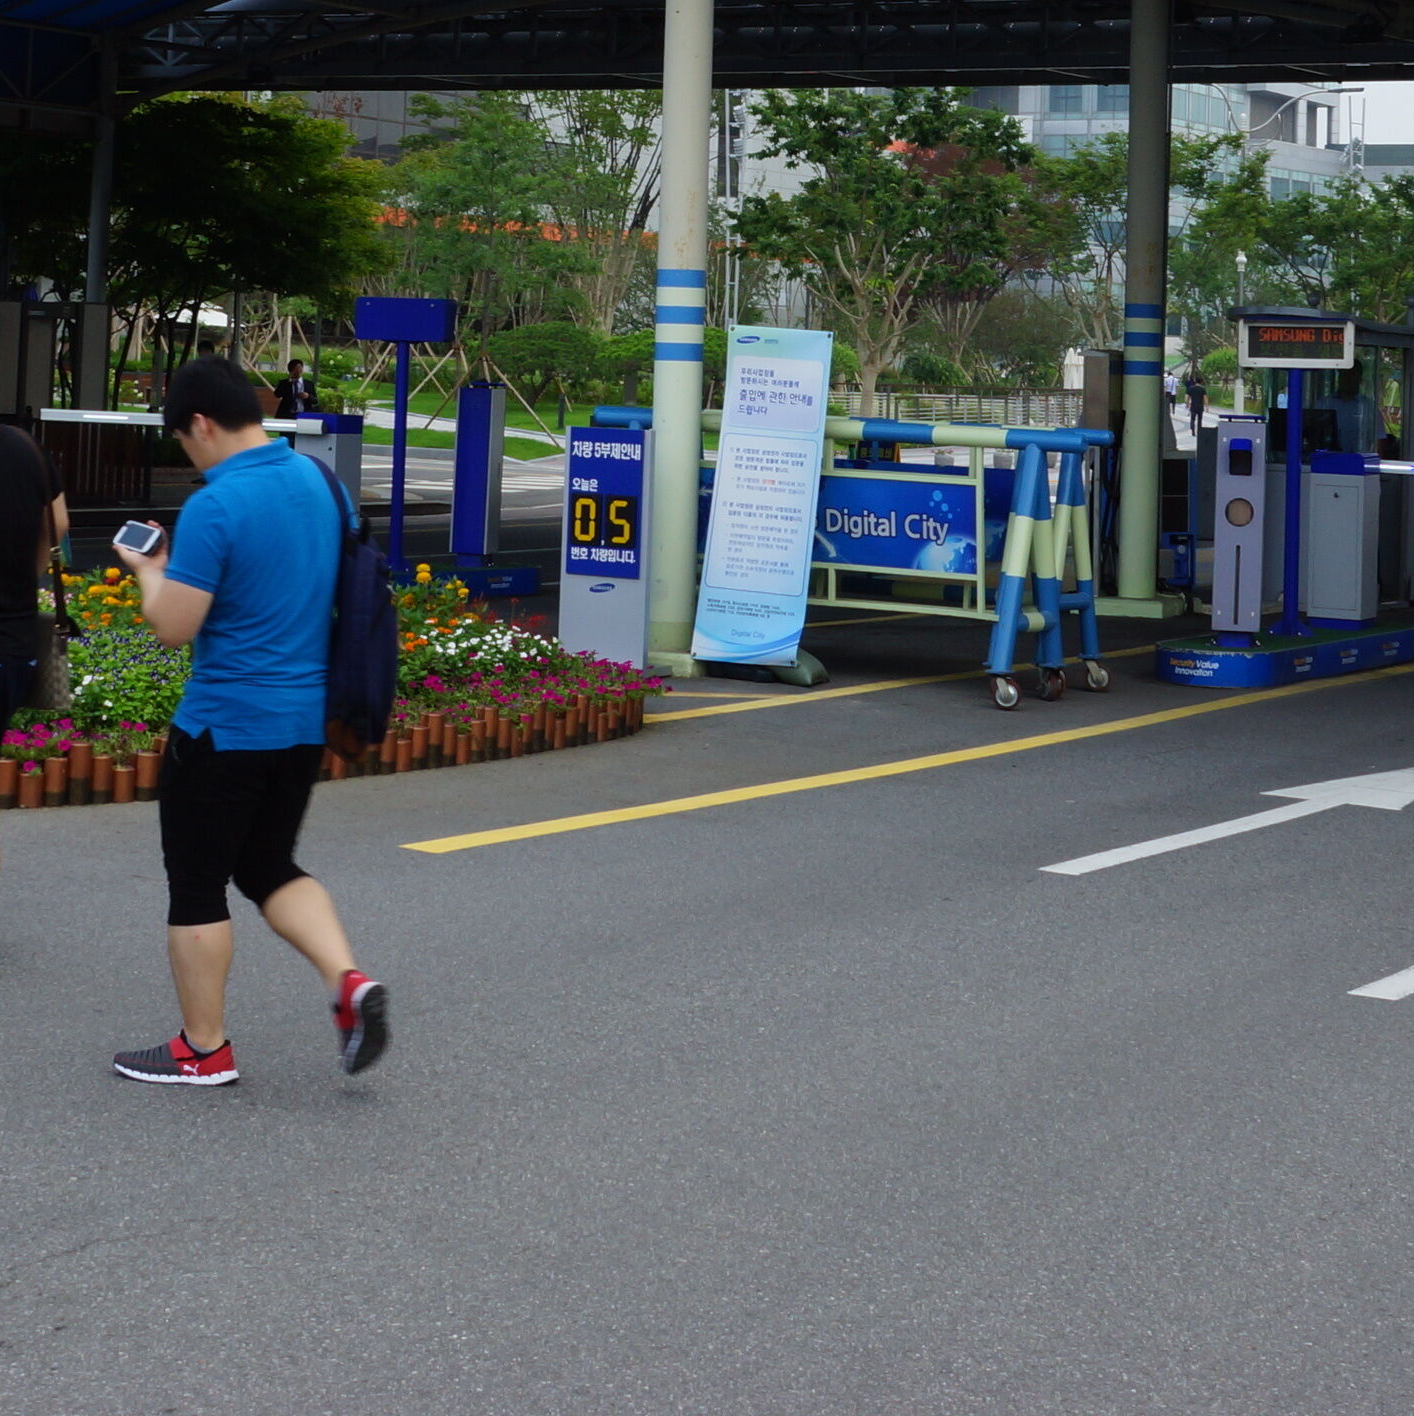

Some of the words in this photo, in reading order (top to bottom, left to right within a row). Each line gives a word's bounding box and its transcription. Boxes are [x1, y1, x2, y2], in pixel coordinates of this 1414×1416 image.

[1259, 328, 1315, 342] SAMSUNG
[769, 391, 787, 404] 관한
[789, 393, 813, 406] 안내를
[738, 405, 768, 415] 드립니다
[572, 441, 592, 459] 차량
[594, 442, 642, 461] 5부제안내
[572, 477, 598, 492] 오늘은
[825, 508, 897, 538] Digital
[904, 513, 949, 545] City
[571, 547, 588, 560] 번호
[590, 548, 636, 564] 차량입니다.
[1175, 666, 1214, 677] Innovation
[1196, 660, 1219, 669] Value
